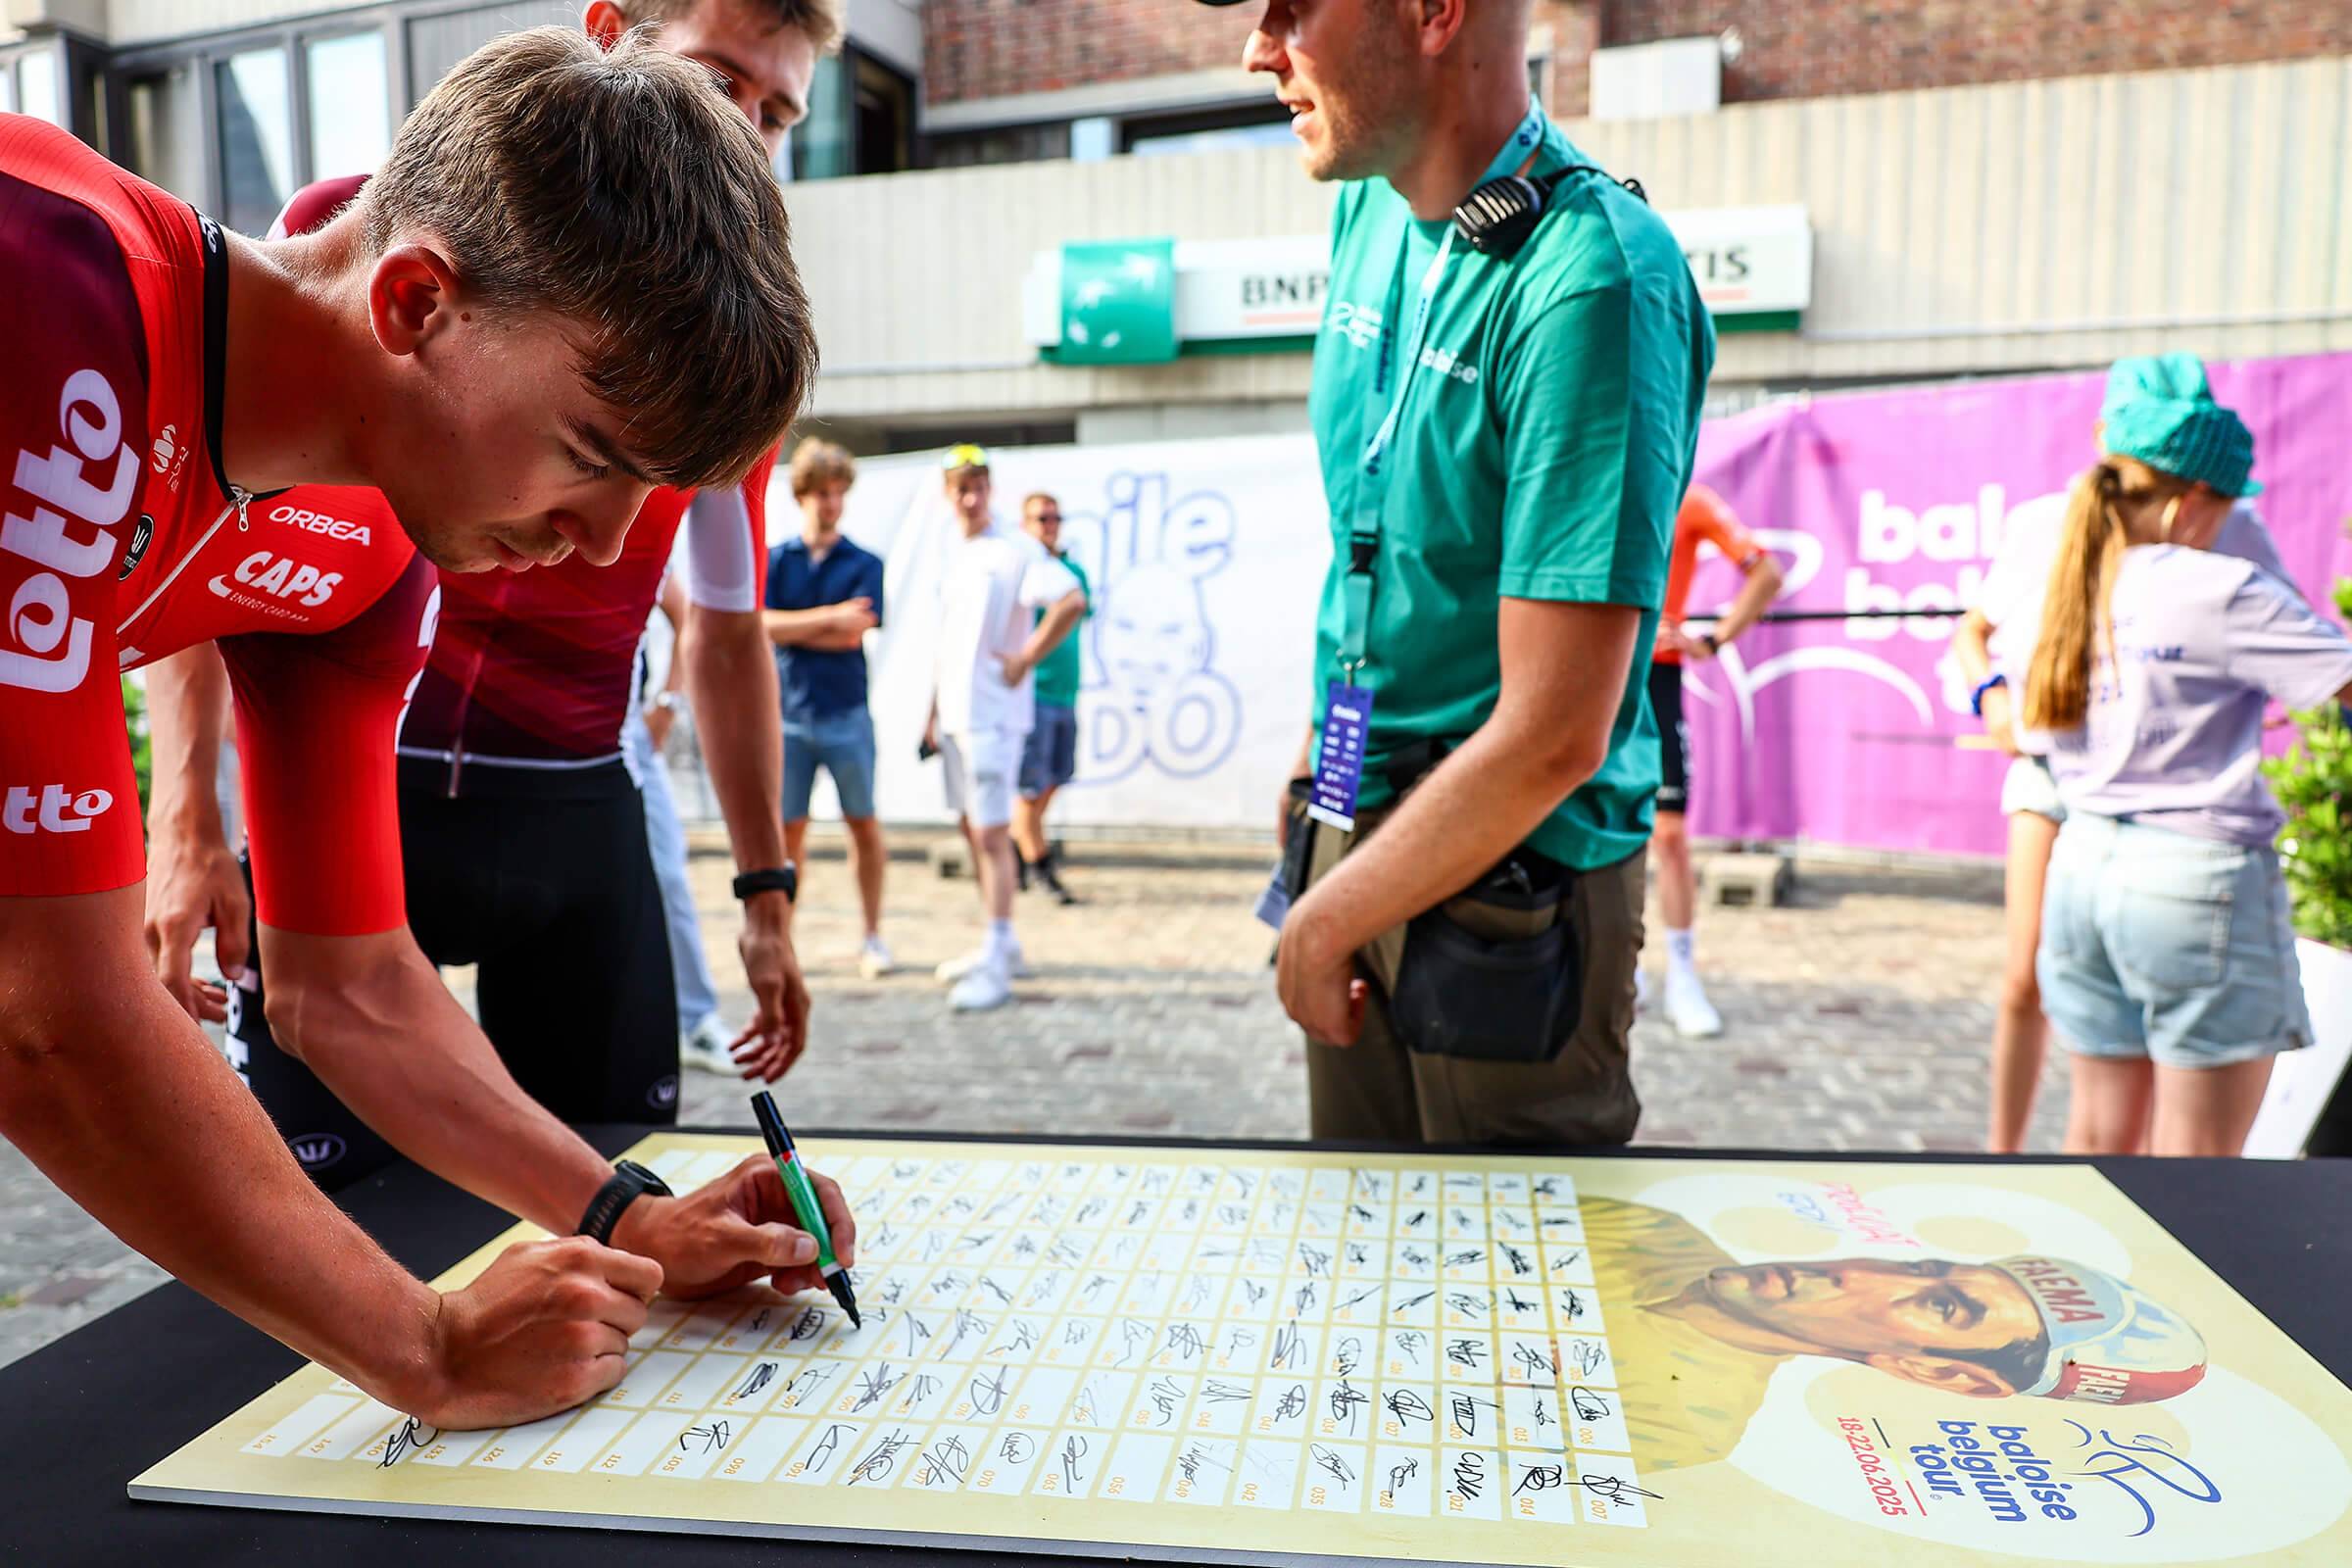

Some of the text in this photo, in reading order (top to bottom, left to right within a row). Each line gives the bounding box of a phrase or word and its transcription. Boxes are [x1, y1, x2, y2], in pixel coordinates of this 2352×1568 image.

[0, 368, 140, 693] lotto
[269, 506, 371, 546] ORBEA
[1858, 483, 2006, 564] bal
[234, 550, 344, 607] CAPS
[2, 784, 114, 833] tto
[2010, 1258, 2106, 1324] FAEMA
[602, 1454, 622, 1469] 112
[662, 1455, 683, 1472] 105
[1909, 1444, 1965, 1496] tour
[1936, 1420, 2028, 1522] belgium
[977, 1469, 996, 1488] 070
[1042, 1473, 1059, 1491] 063
[1986, 1425, 2077, 1521] baloise
[1107, 1476, 1125, 1494] 056
[1176, 1479, 1193, 1498] 049
[1241, 1483, 1258, 1501] 042
[1310, 1487, 1326, 1505] 035
[1379, 1490, 1395, 1508] 028
[1449, 1494, 1464, 1512] 021
[1520, 1497, 1536, 1515] 014
[1591, 1499, 1608, 1520] 007
